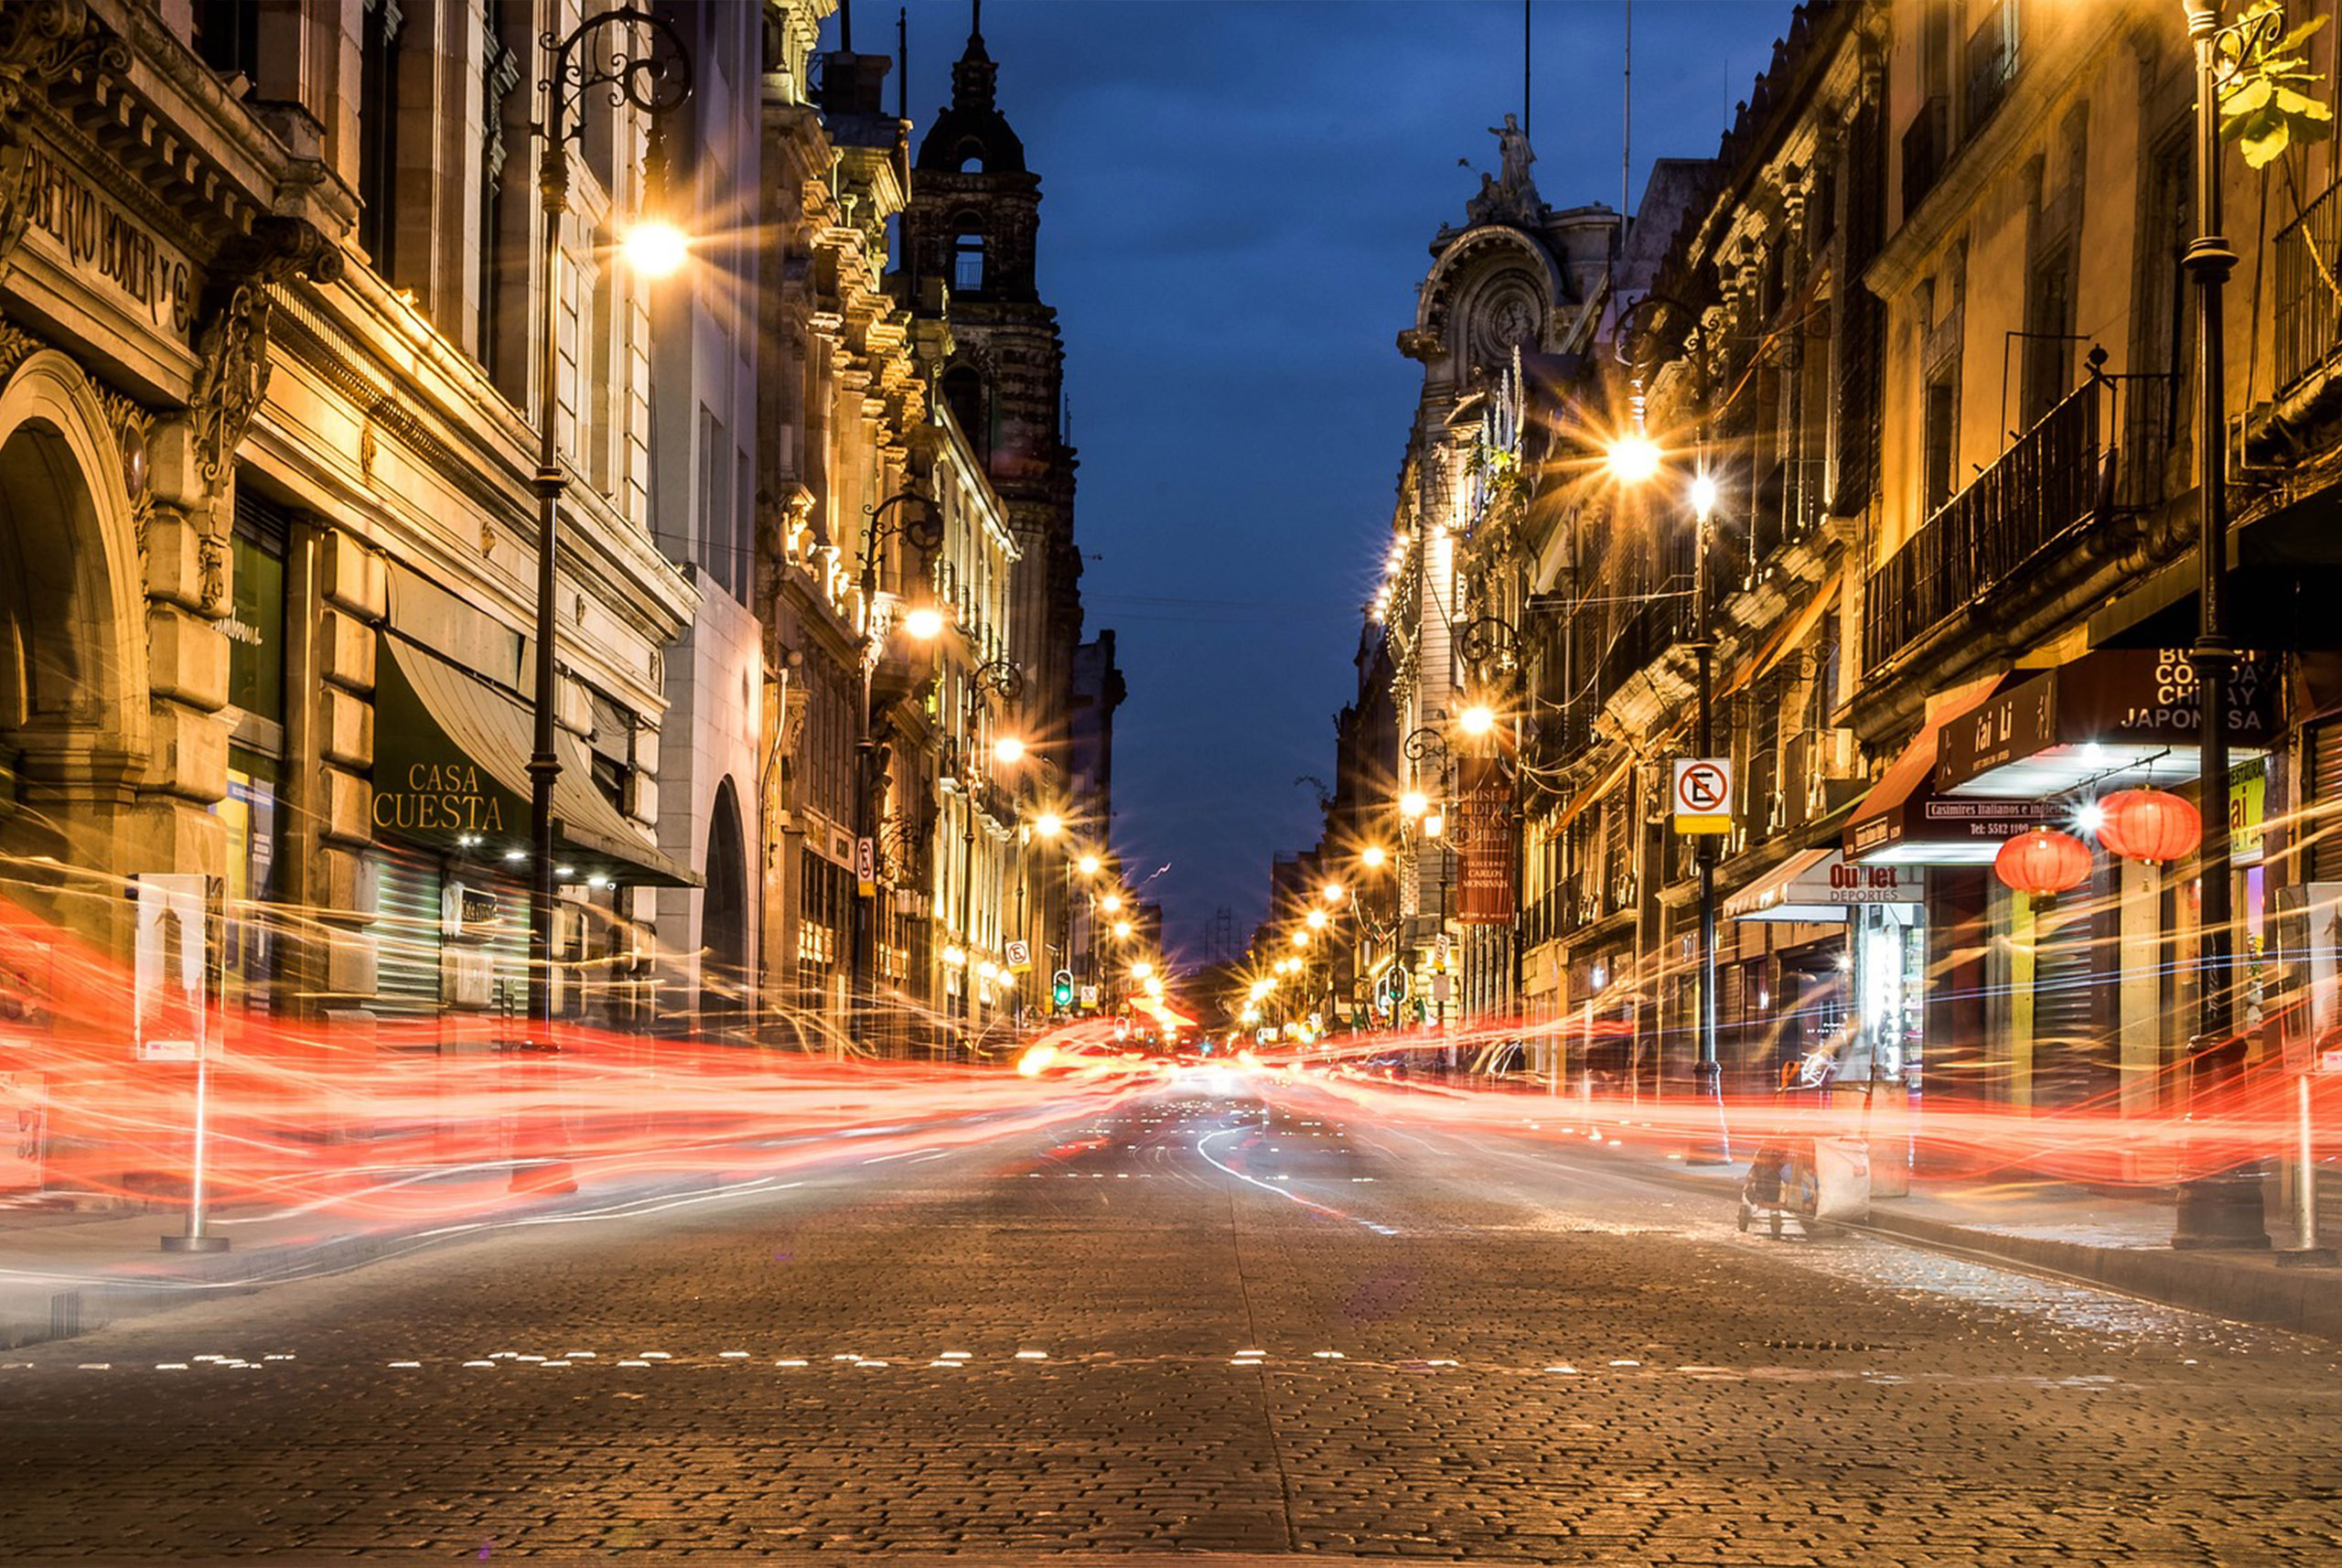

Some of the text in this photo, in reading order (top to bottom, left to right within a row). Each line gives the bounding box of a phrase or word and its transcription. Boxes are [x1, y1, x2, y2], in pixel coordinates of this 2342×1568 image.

[2240, 686, 2256, 706] Y
[2120, 708, 2262, 730] JAPONSA
[409, 763, 478, 793] CASA
[1692, 772, 1718, 802] E
[372, 792, 503, 831] CUESTA
[1931, 804, 1976, 816] Casimires
[1978, 804, 2020, 816] Italianos
[1831, 890, 1898, 902] DEPORTES
